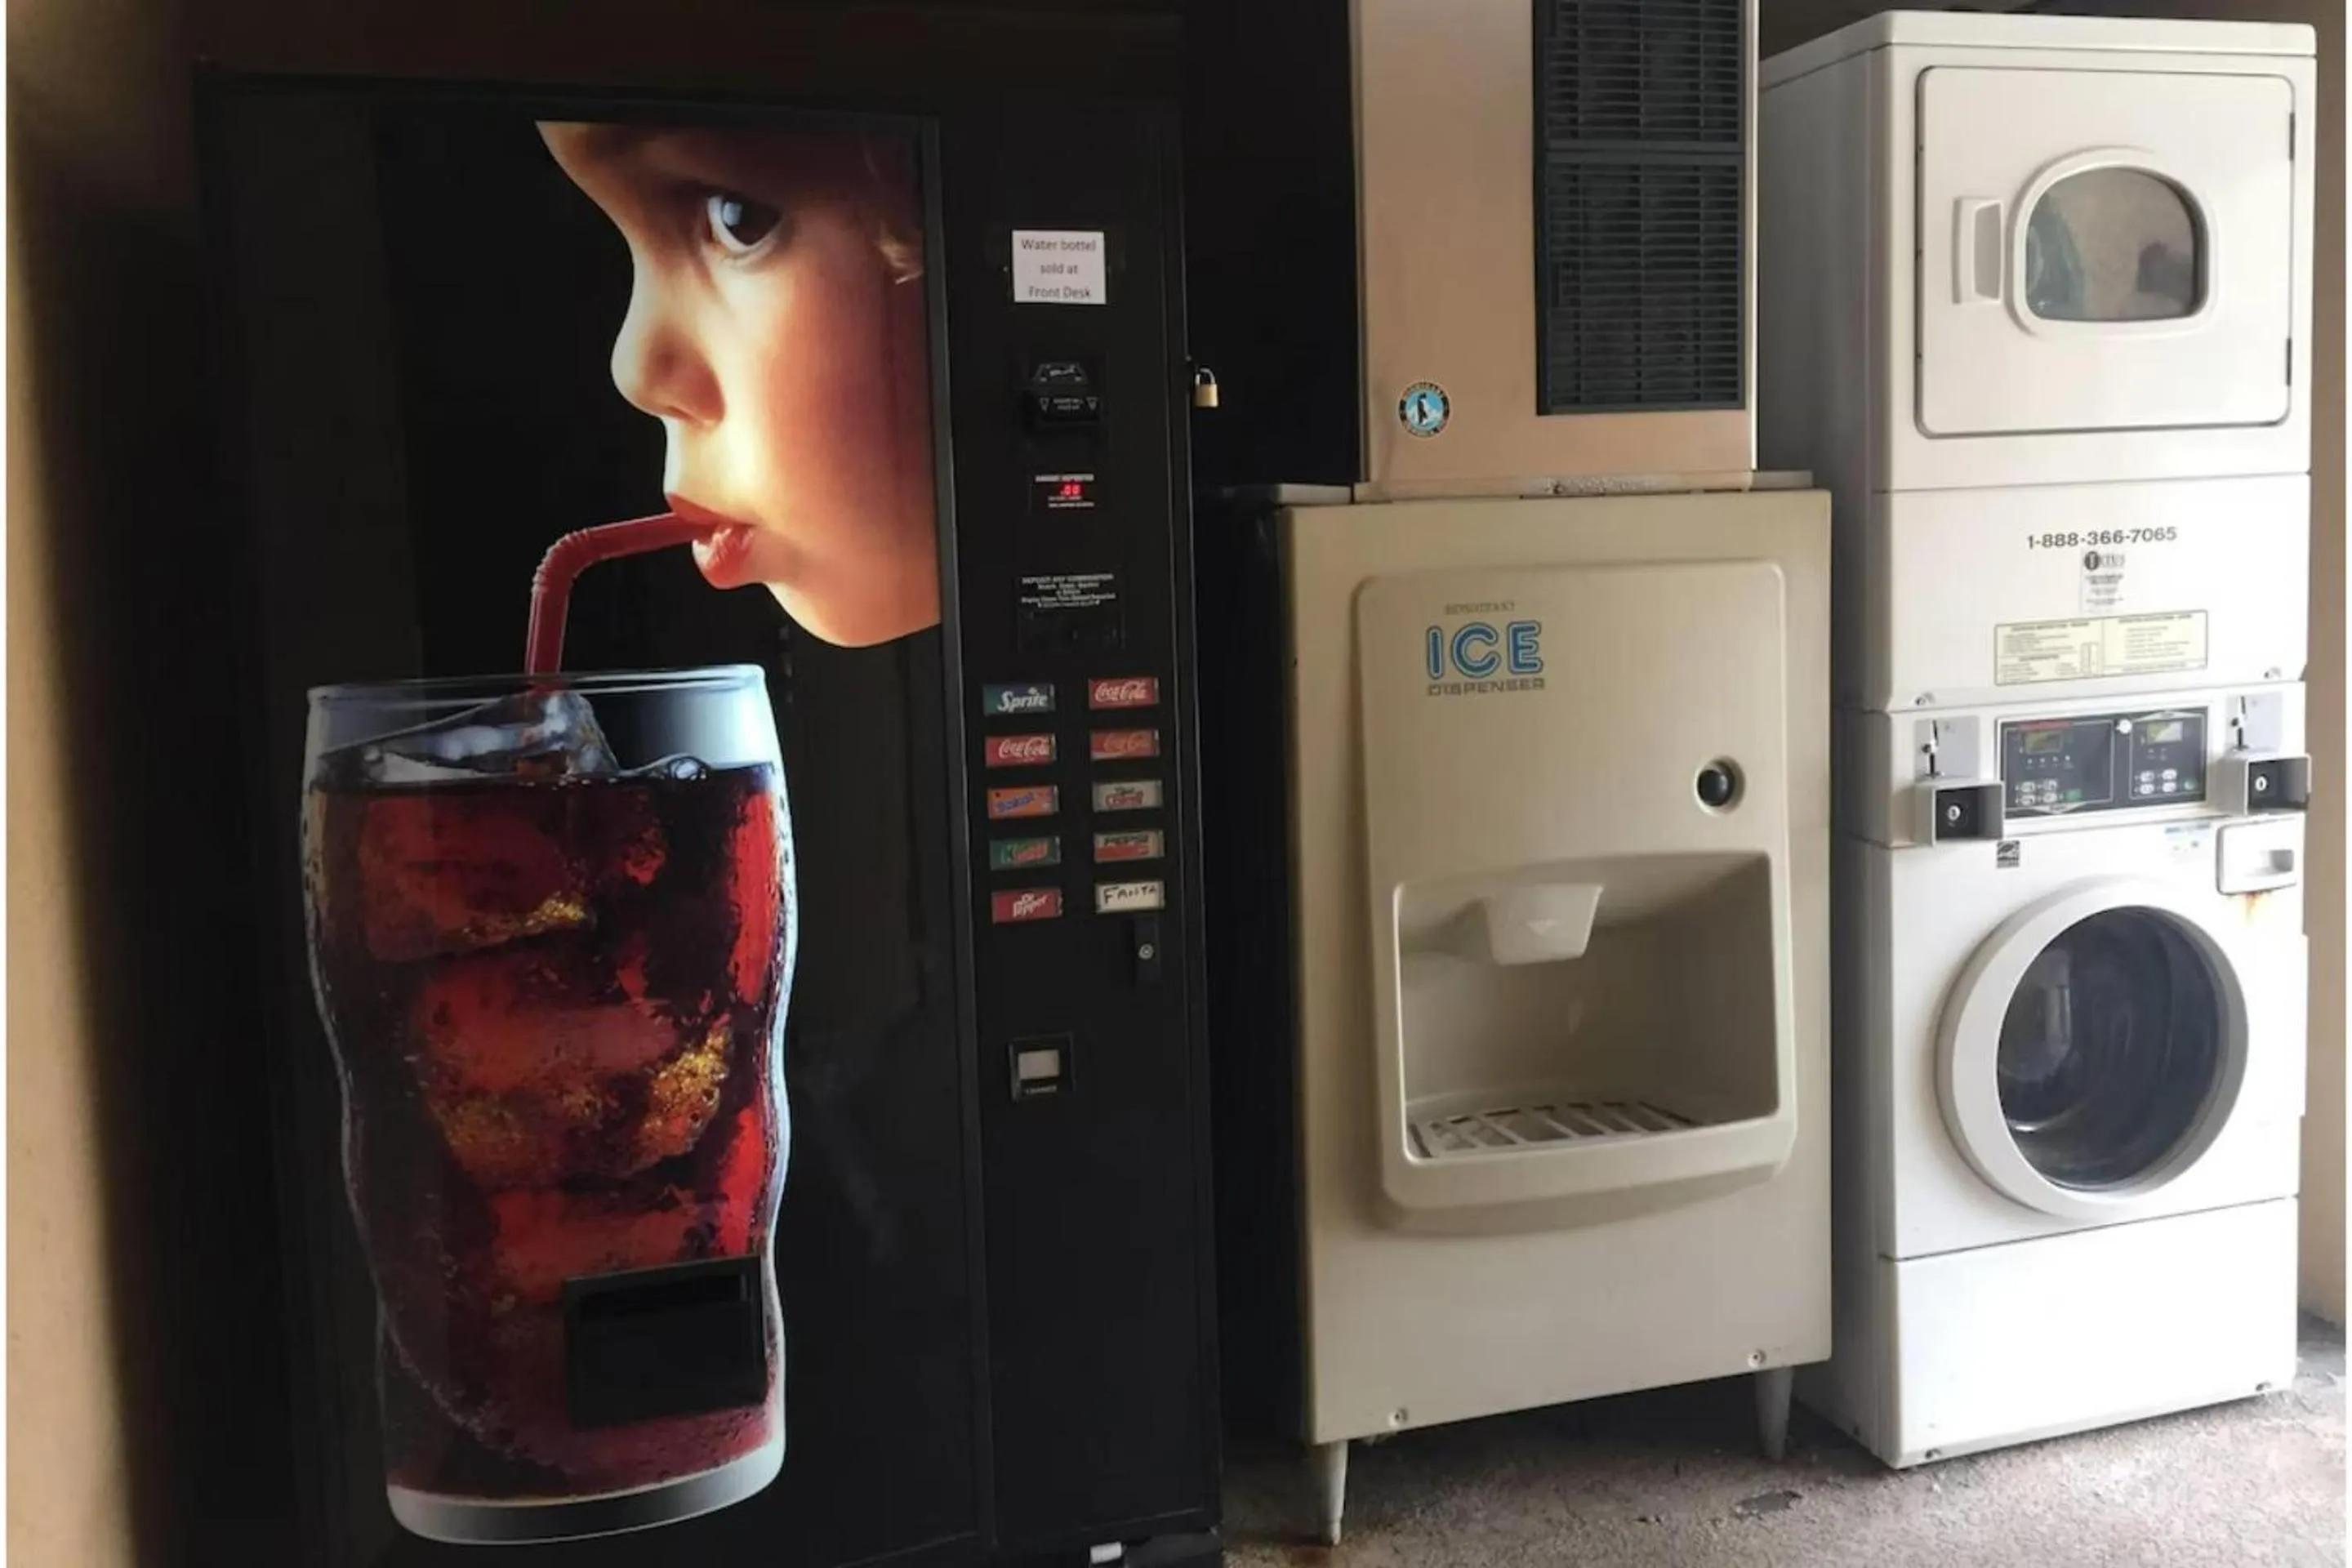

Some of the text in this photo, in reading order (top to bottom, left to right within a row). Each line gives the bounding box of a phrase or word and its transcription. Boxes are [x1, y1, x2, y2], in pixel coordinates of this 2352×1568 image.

[1021, 238, 1097, 252] Water bottel
[1040, 263, 1079, 274] sold at
[1028, 286, 1092, 299] Front Desk
[2026, 526, 2178, 550] 1-888-366-7065
[1426, 619, 1544, 680] ICE
[1427, 677, 1546, 697] DISPENSER
[996, 687, 1049, 713] Sprite
